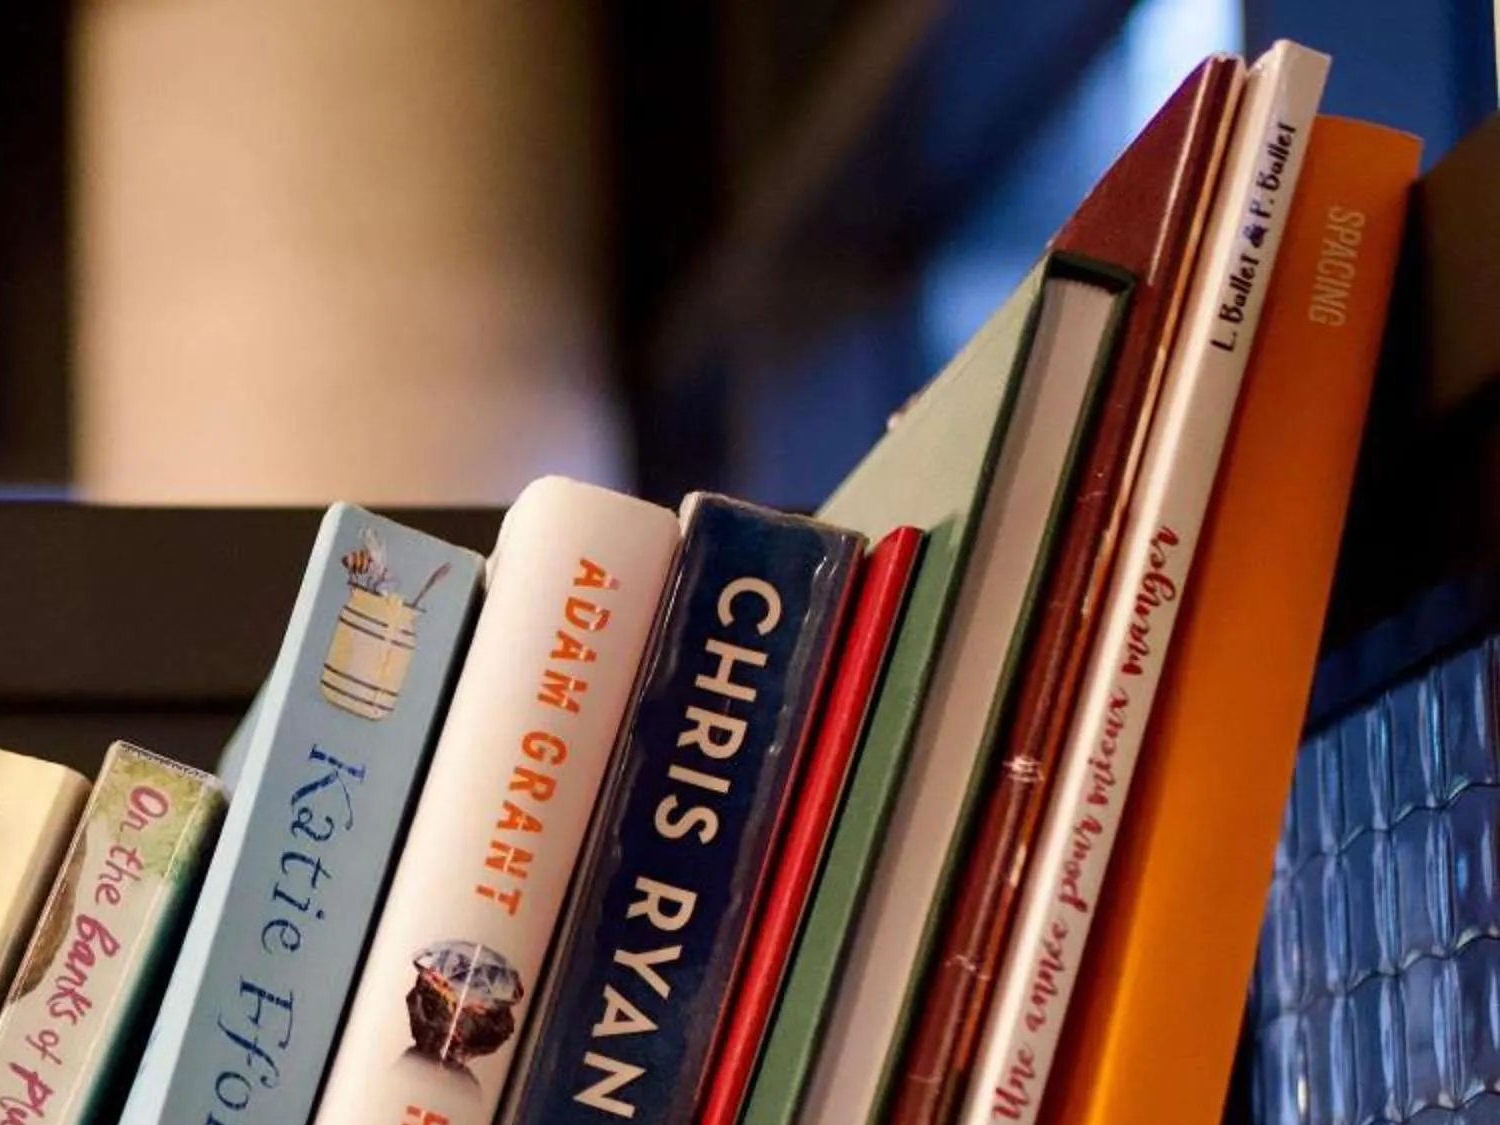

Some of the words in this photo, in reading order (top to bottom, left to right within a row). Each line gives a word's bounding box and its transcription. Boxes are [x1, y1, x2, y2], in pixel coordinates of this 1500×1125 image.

[1219, 255, 1259, 323] Ballet
[1256, 121, 1297, 191] Ballet
[1308, 205, 1366, 328] SPACING
[536, 557, 621, 718] ADAM
[653, 575, 784, 848] CHRIS
[94, 843, 148, 907] the
[118, 784, 169, 832] On
[260, 743, 366, 956] Katie
[475, 729, 569, 917] GRANT
[989, 1043, 1037, 1124] Une
[1025, 918, 1070, 1034] année
[1057, 813, 1105, 912] pour
[1085, 687, 1130, 809] mieux
[1121, 522, 1182, 678] manger
[26, 1028, 62, 1066] of
[571, 875, 699, 1120] RYAN
